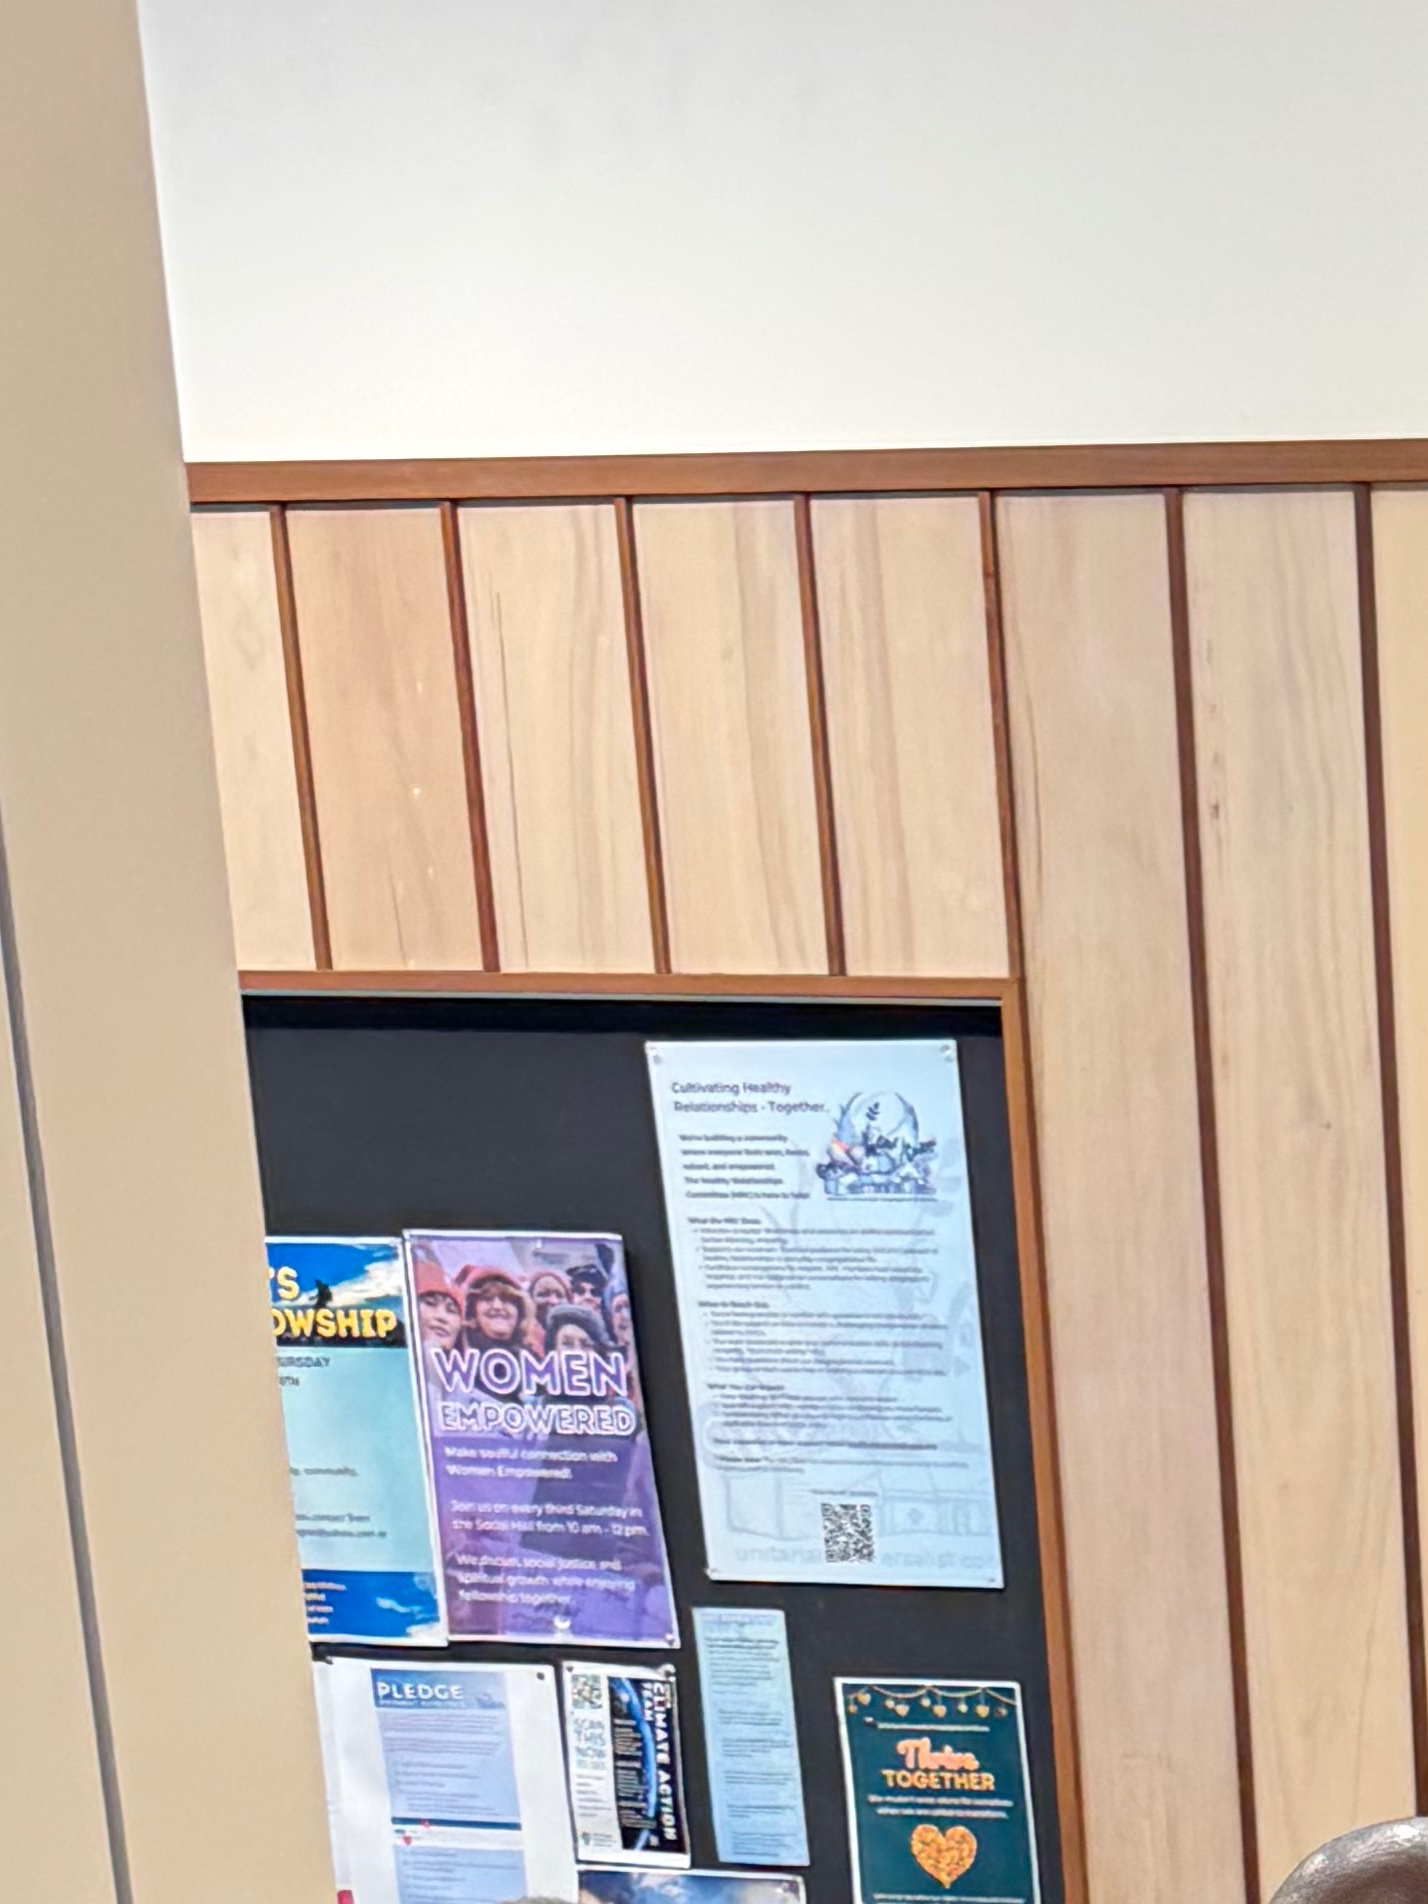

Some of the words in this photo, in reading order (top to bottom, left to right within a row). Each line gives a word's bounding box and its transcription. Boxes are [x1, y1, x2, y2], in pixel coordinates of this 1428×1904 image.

[671, 1082, 740, 1096] Cultivating
[743, 1082, 791, 1096] Healthy
[271, 1308, 397, 1338] OWSHIP
[277, 1356, 331, 1368] URSDAY
[431, 1349, 628, 1397] WOMEN
[440, 1401, 637, 1436] EMPOWERED
[376, 1682, 464, 1700] PLEDGE
[652, 1681, 670, 1765] CLIMATE
[896, 1737, 980, 1770] Thrive
[881, 1769, 995, 1791] TOGETHER
[658, 1770, 678, 1841] ACTION
